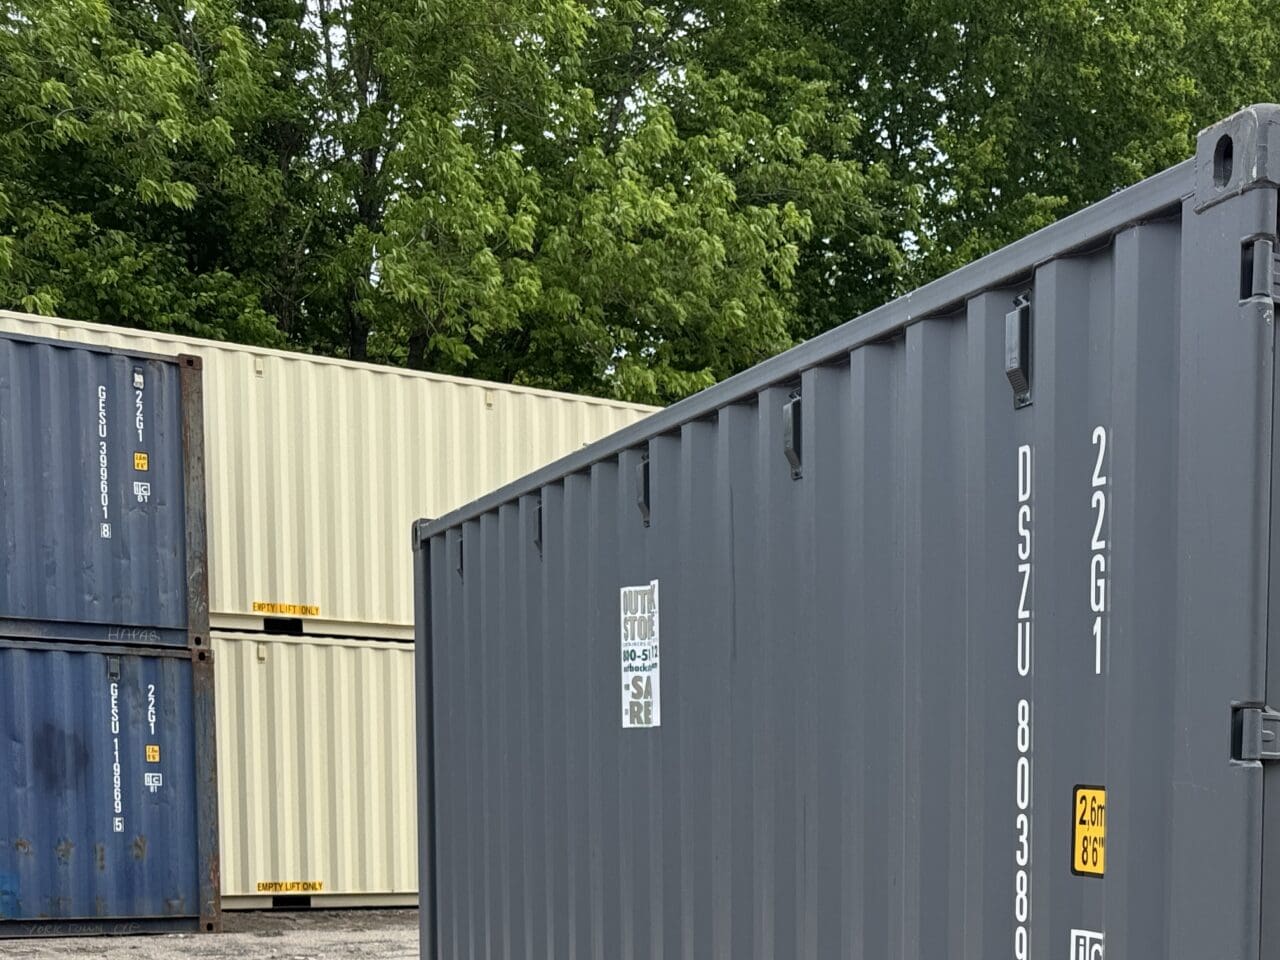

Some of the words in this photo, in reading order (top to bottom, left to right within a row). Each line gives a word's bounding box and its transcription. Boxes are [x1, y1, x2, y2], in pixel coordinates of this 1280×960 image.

[98, 385, 107, 438] GESU
[135, 390, 144, 442] 22G1
[99, 441, 109, 519] 399601
[101, 523, 110, 538] 8
[1090, 425, 1107, 675] 22G1
[1017, 444, 1032, 677] DSZU
[252, 602, 275, 612] EMPTY
[280, 604, 296, 614] LIFT
[301, 605, 320, 616] ONLY
[110, 683, 119, 734] GESU
[148, 684, 156, 735] 22G1
[113, 737, 122, 814] 119969
[114, 817, 123, 832] 5
[257, 882, 284, 892] EMPTY
[285, 882, 301, 891] LIFT
[302, 881, 323, 891] ONLY
